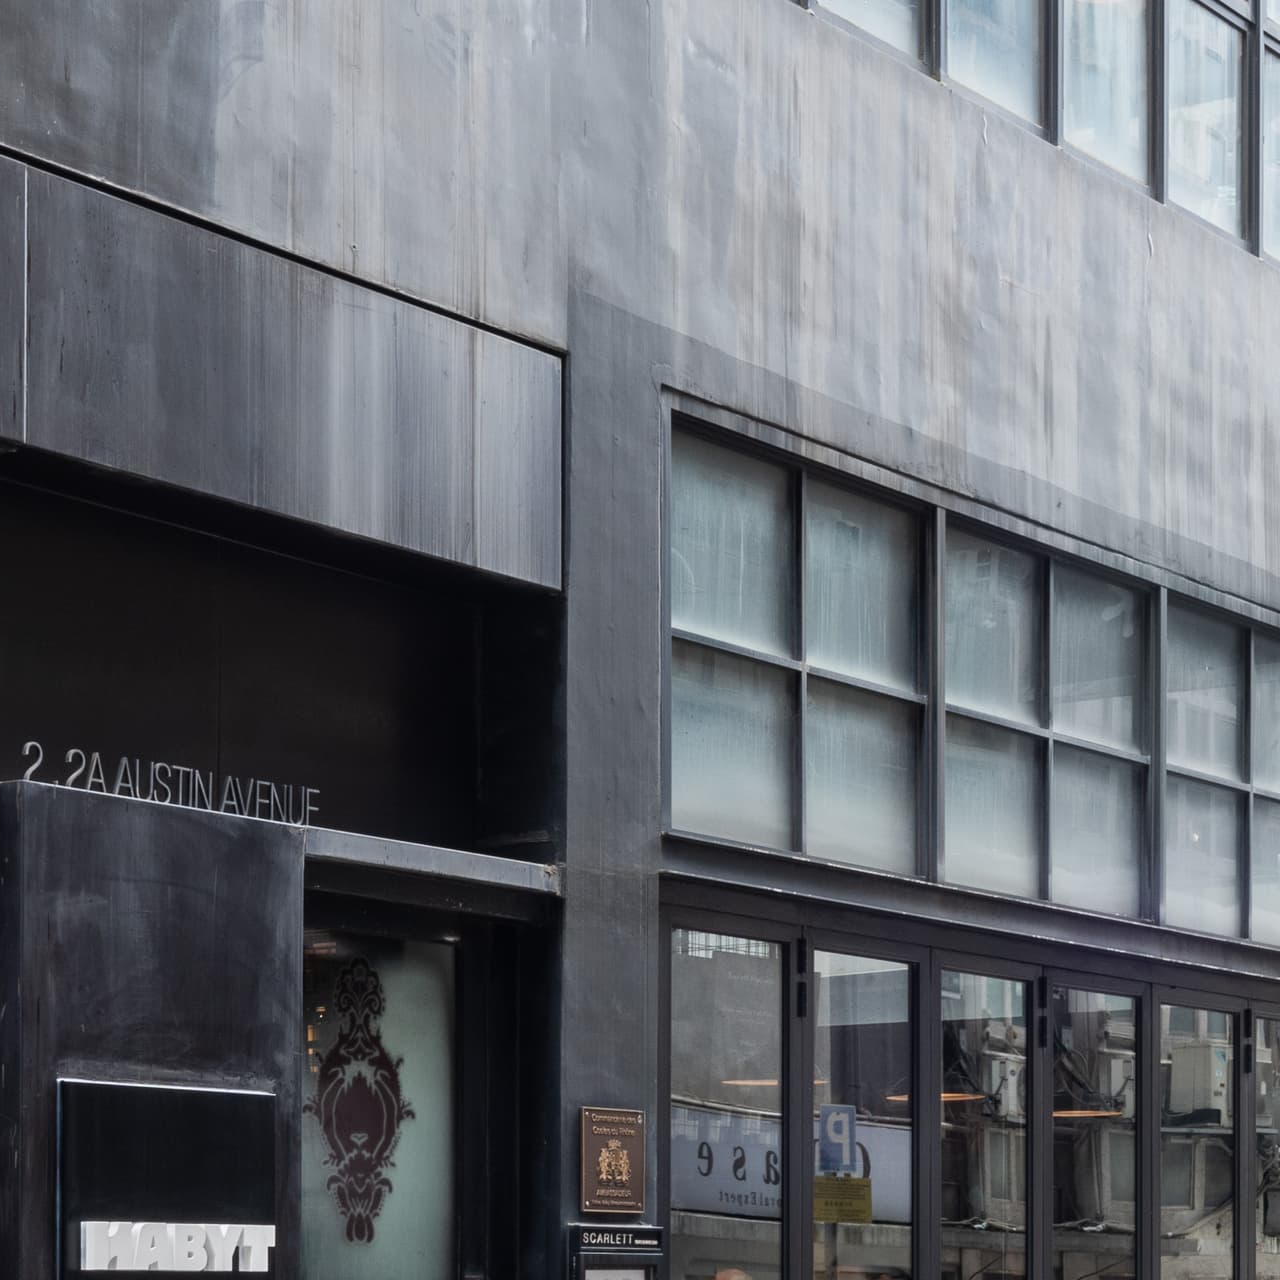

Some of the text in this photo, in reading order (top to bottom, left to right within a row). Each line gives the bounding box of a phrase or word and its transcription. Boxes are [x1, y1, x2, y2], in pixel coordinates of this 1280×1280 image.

[65, 749, 108, 794] 2A
[114, 757, 214, 812] AUSTIN
[221, 775, 320, 828] AVENUE
[81, 1221, 275, 1272] HABYT
[582, 1232, 633, 1245] SCARLETT
